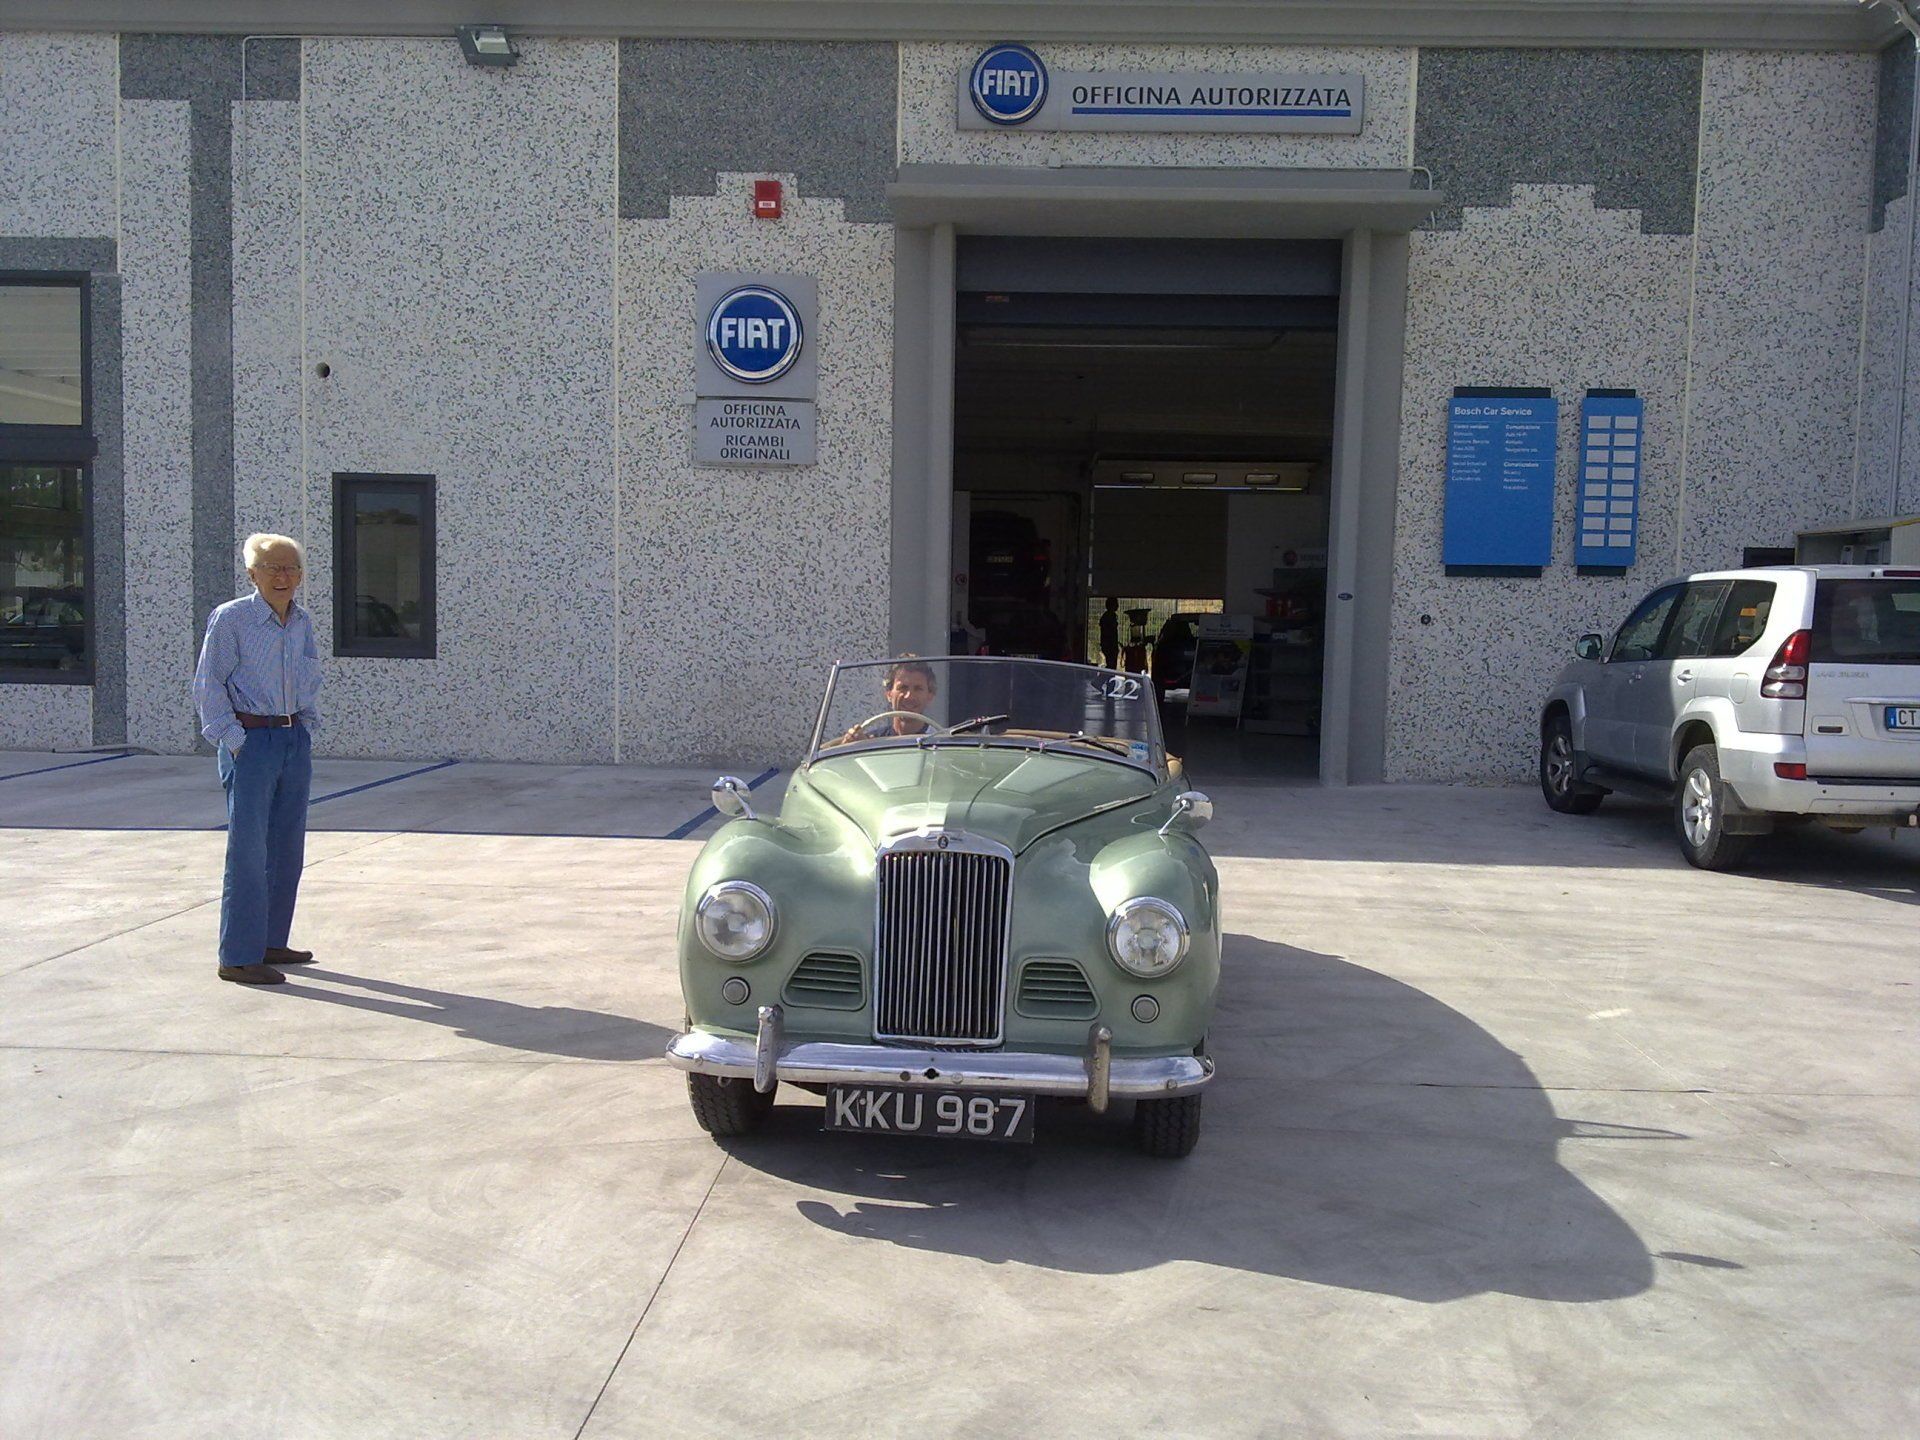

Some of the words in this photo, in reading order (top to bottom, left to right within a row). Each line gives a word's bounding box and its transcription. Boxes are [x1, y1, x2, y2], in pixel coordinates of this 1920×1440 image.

[982, 69, 1036, 96] FIAT
[1072, 86, 1181, 106] OFFICINA
[1191, 87, 1351, 107] AUTORIZZATA
[721, 318, 785, 349] FIAT
[723, 404, 786, 416] OFFICINA
[1454, 407, 1481, 415] Bosch
[1483, 407, 1499, 415] Car
[1500, 407, 1532, 416] Service
[710, 417, 801, 430] AUTORIZZATA
[725, 435, 784, 447] RICAMBI
[720, 448, 790, 460] ORIGINALI
[834, 1088, 923, 1131] KKU
[936, 1095, 1026, 1137] 987
